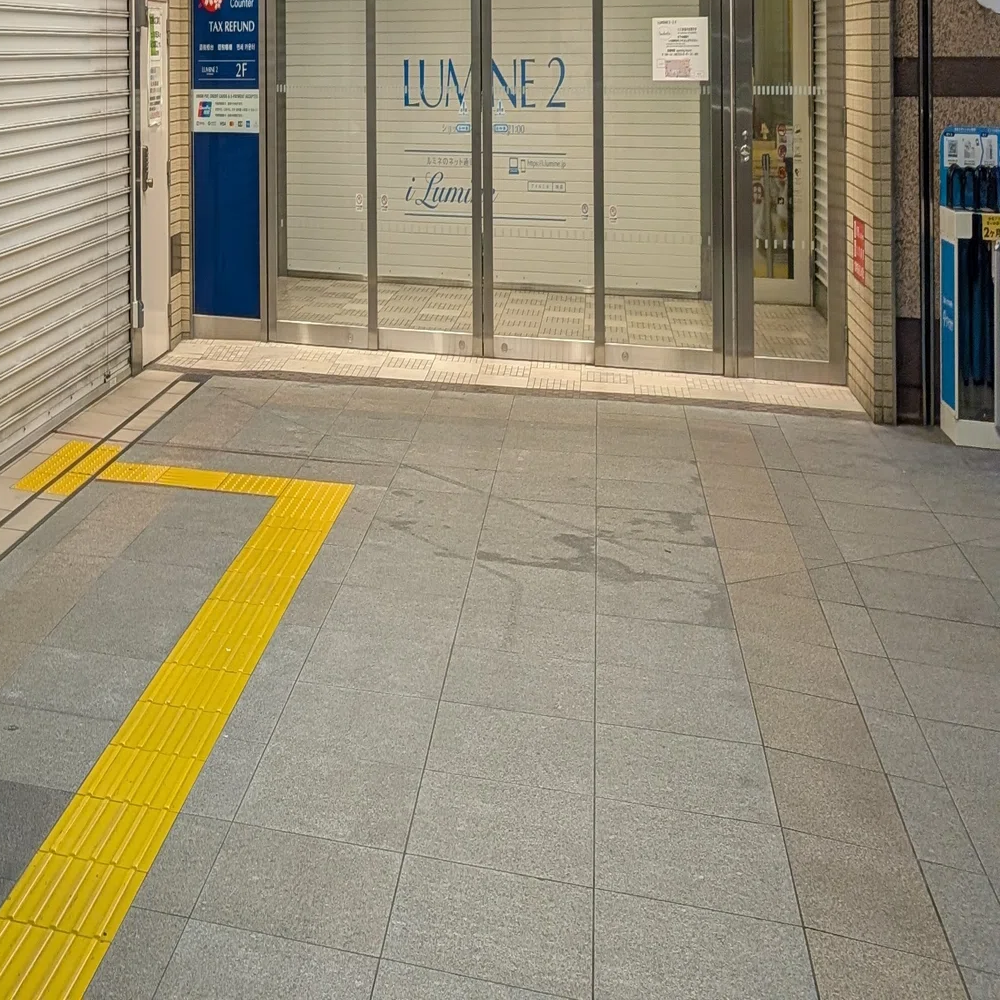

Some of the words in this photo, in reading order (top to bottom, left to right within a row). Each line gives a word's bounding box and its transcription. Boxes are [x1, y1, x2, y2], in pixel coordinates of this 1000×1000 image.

[209, 21, 223, 32] TAX
[224, 21, 255, 32] REFUND
[235, 63, 248, 77] 2F
[403, 58, 536, 108] LUMNE
[546, 57, 566, 108] 2
[405, 177, 415, 201] i
